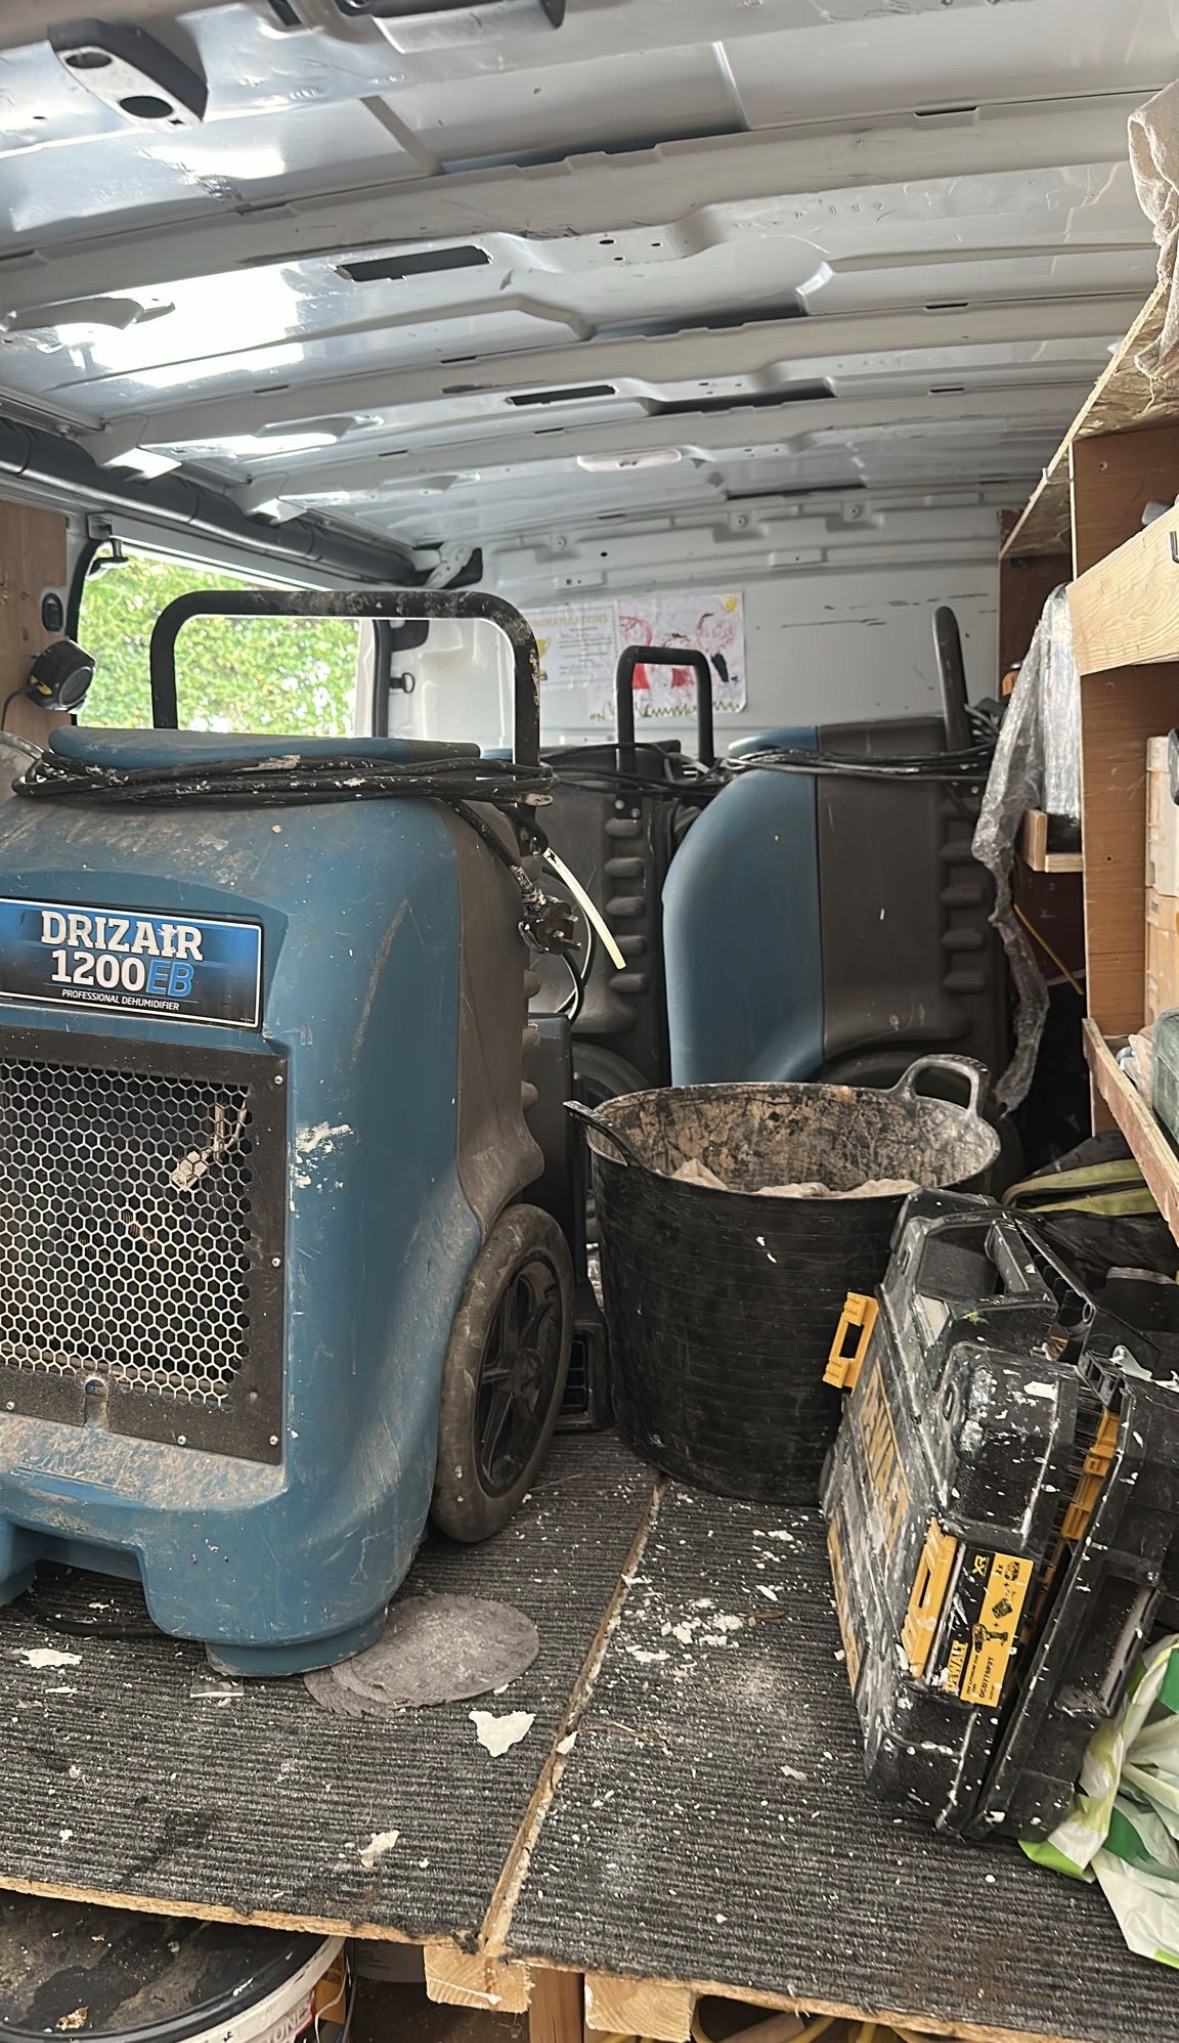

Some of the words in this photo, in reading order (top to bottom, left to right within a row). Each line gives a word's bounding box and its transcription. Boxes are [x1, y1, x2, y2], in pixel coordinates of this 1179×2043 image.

[41, 910, 203, 961] DRIZAIR
[51, 949, 195, 998] 1200EB
[61, 988, 120, 1004] PROFESSIONAL
[121, 995, 180, 1012] DEHUMIDIFIER
[972, 1555, 989, 1577] XR
